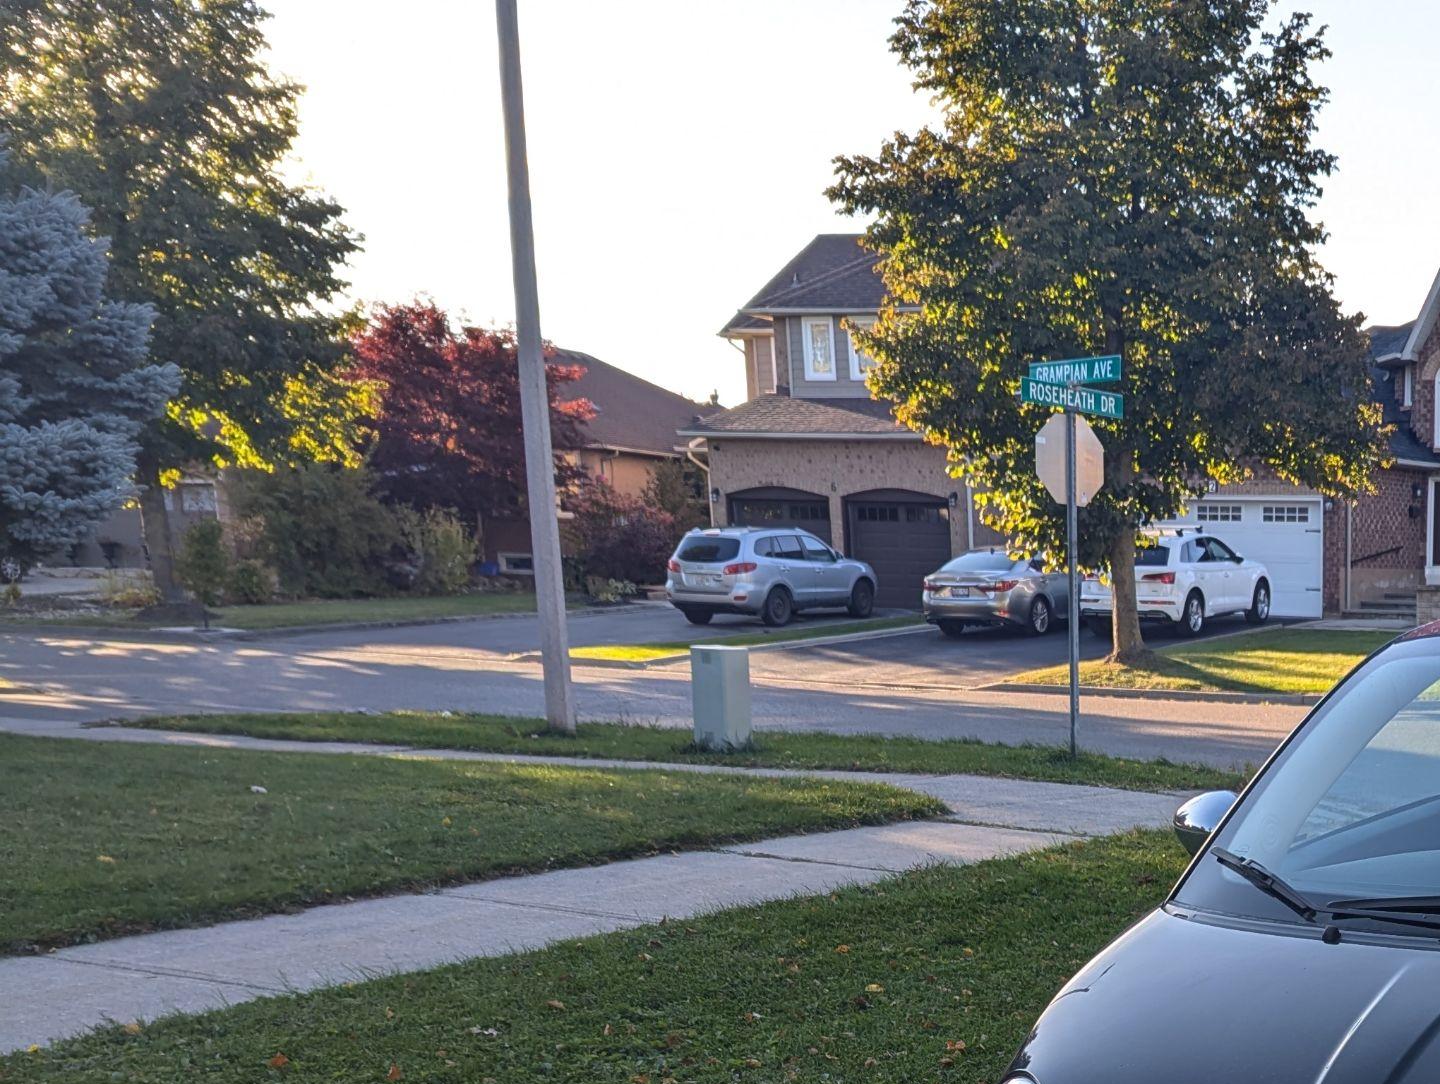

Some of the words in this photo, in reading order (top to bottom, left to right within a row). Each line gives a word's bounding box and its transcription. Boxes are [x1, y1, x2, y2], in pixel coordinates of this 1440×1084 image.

[1036, 362, 1088, 383] GRAMPIAN
[1093, 360, 1113, 379] AVE
[1029, 382, 1095, 410] ROSEHEATH
[1101, 395, 1116, 414] DR
